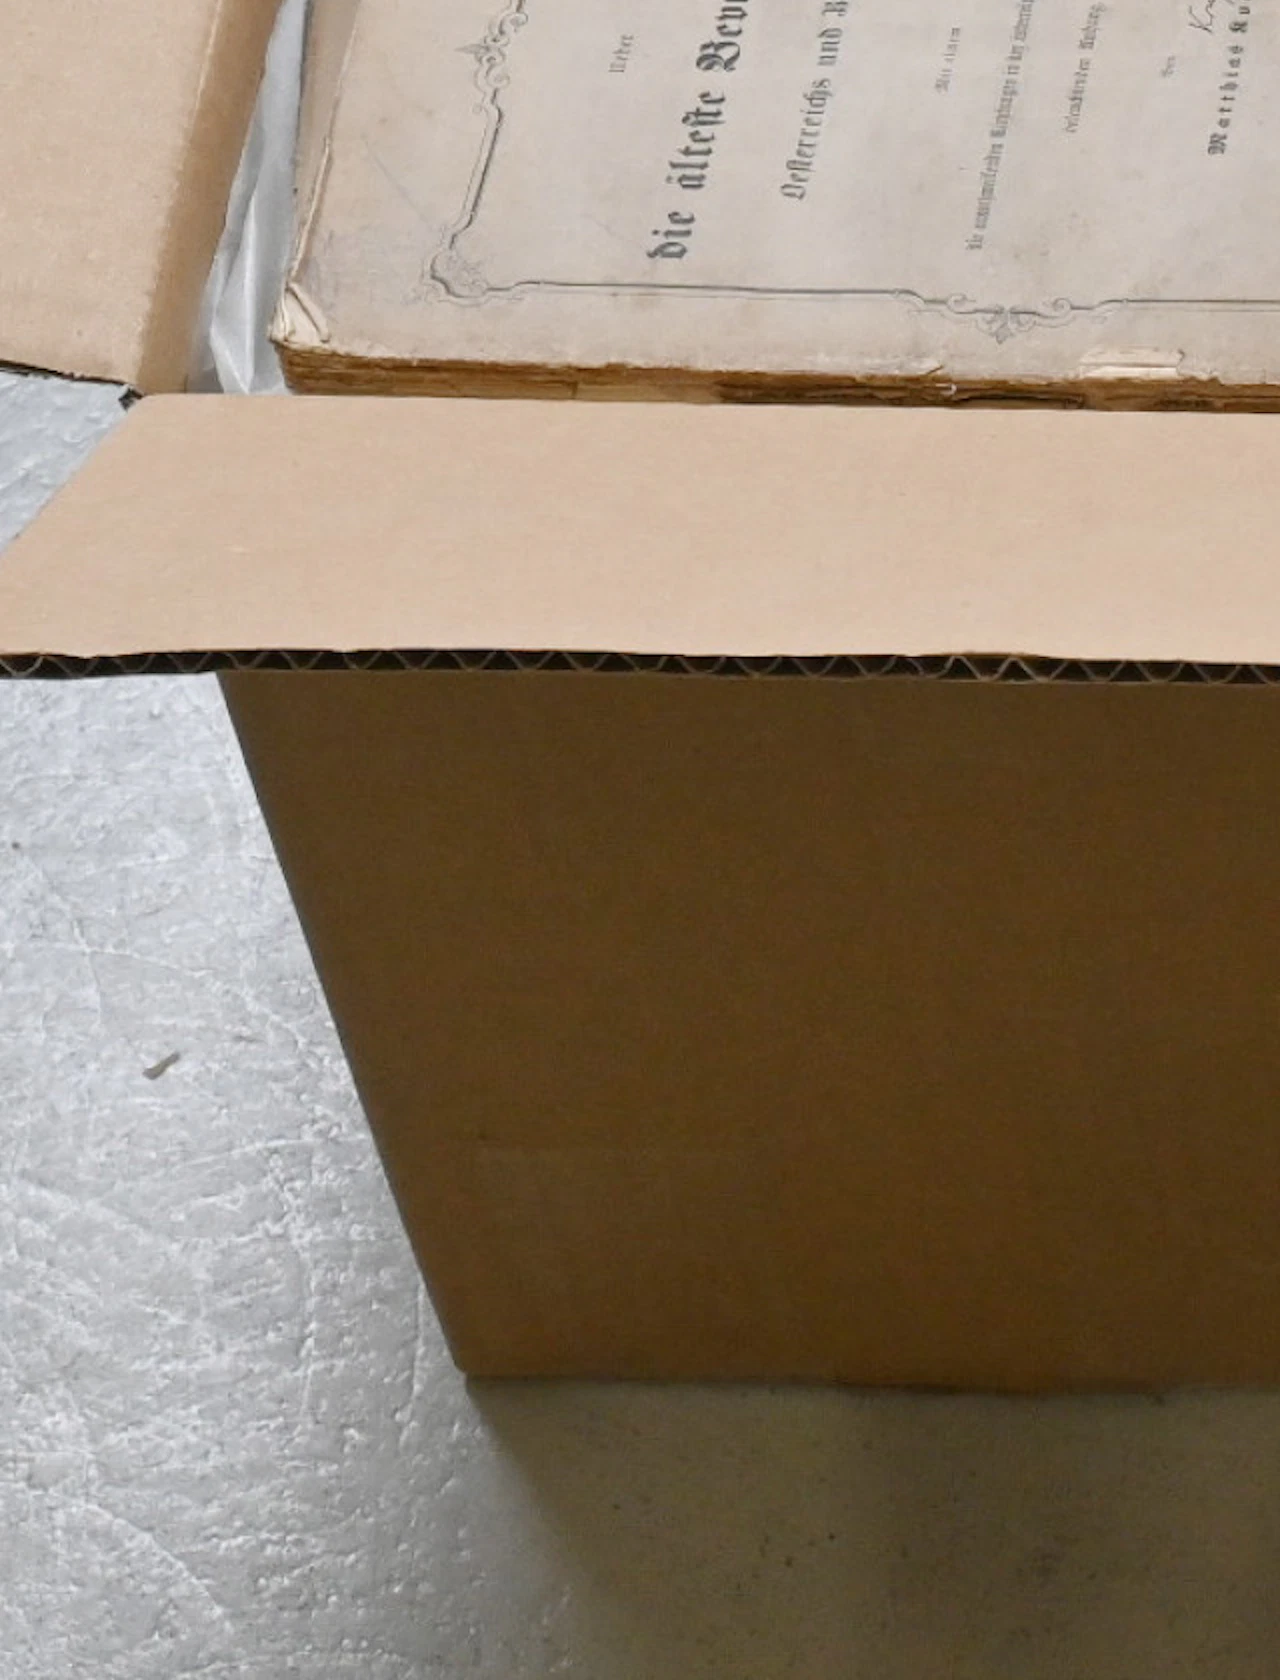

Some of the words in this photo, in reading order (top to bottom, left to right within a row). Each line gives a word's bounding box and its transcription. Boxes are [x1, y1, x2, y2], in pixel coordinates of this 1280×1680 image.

[816, 26, 843, 68] und
[1207, 43, 1245, 155] Matthias
[665, 89, 726, 191] älteste
[645, 210, 696, 261] die
